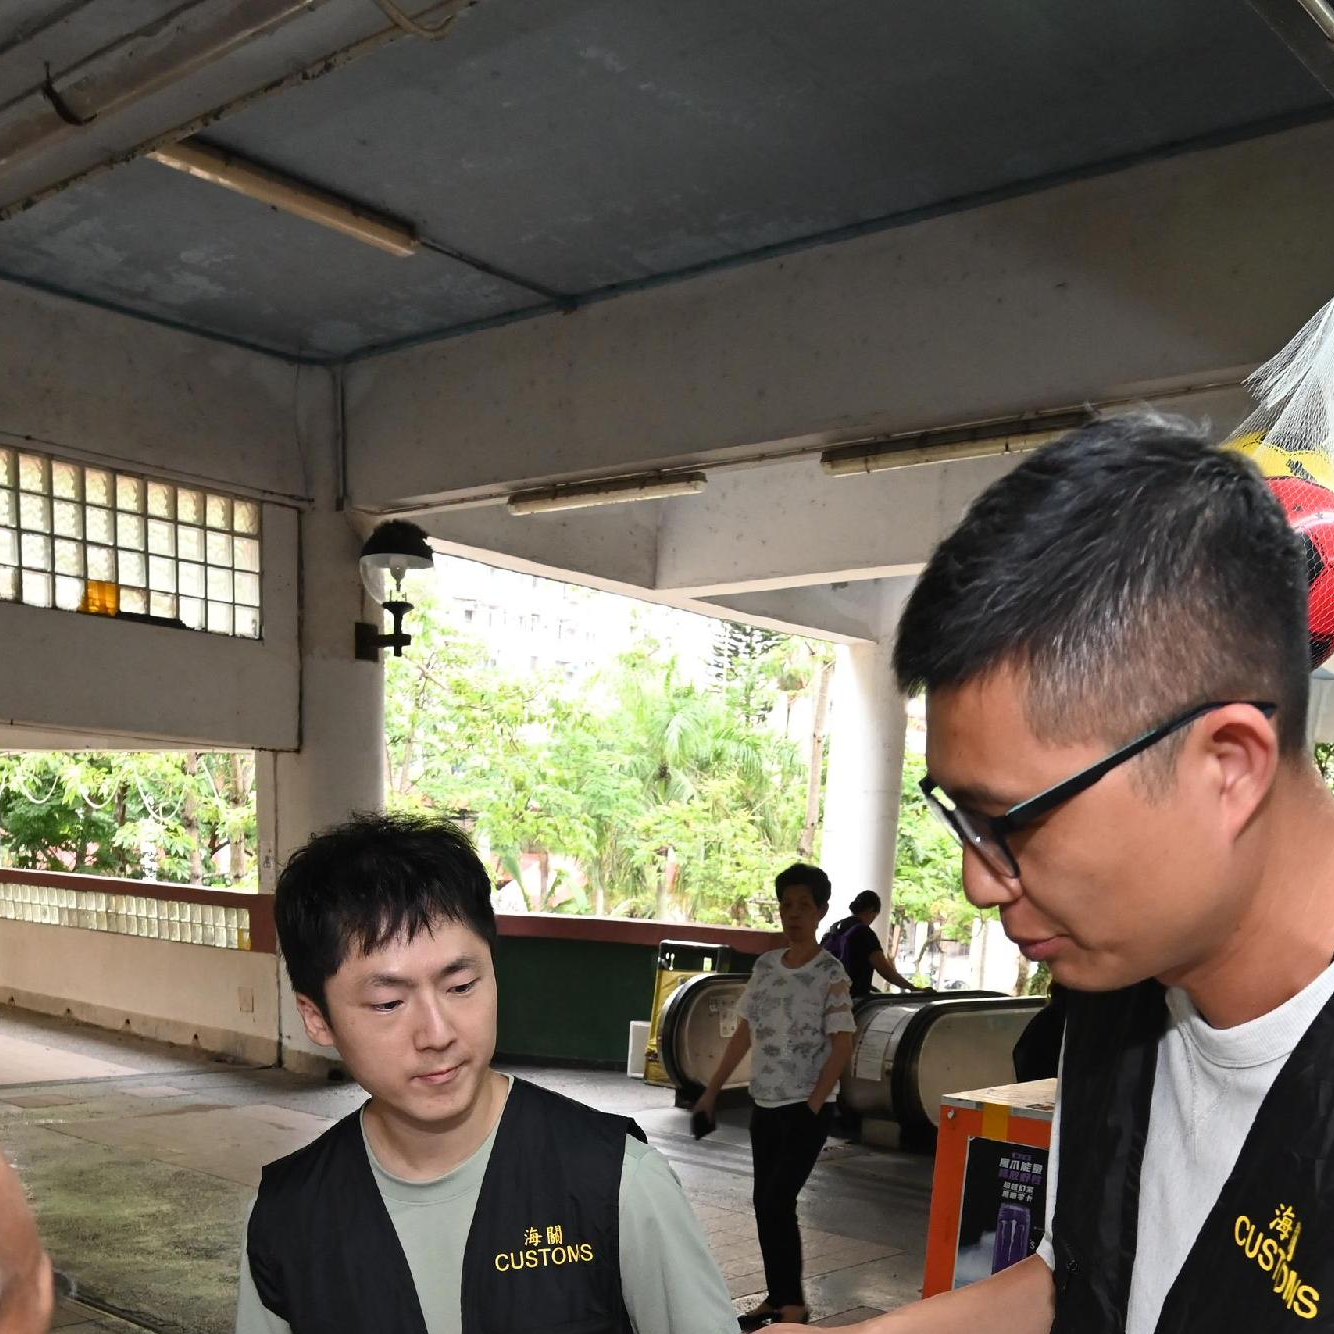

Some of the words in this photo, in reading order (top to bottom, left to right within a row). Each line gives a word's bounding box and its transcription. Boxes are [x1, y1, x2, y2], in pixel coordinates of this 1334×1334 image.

[524, 1225, 563, 1247] 海關
[494, 1243, 595, 1273] CUSTOMS
[1234, 1214, 1321, 1320] CUSTOMS
